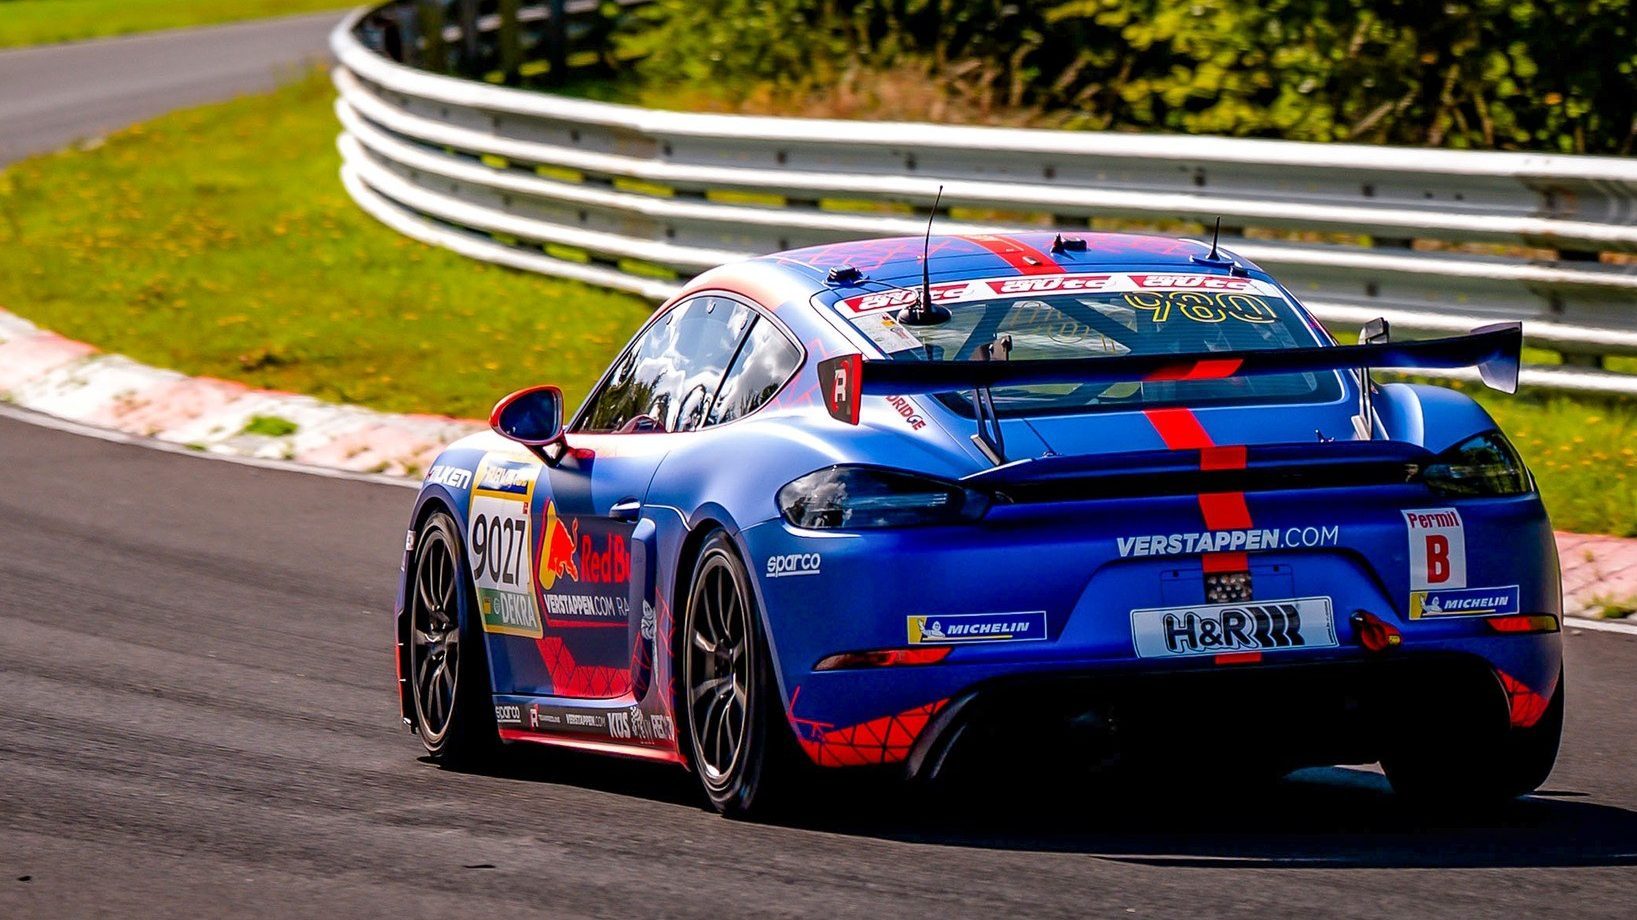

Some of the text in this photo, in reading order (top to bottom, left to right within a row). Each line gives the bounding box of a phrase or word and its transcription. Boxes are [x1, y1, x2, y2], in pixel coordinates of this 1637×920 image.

[1123, 291, 1277, 323] 980
[428, 465, 472, 490] ALKEN
[1407, 511, 1460, 528] Permit
[472, 513, 526, 587] 9027
[1116, 525, 1339, 557] VERSTAPPEN.COM
[581, 532, 611, 583] Red
[767, 553, 821, 577] sparco
[1425, 534, 1450, 584] B
[500, 593, 537, 628] DEKRA
[543, 593, 615, 617] VERSTAPPEN.COM
[1444, 596, 1509, 609] MICHELIN
[947, 621, 1030, 635] MICHELIN
[1164, 609, 1254, 651] H&R
[495, 706, 521, 723] sparco
